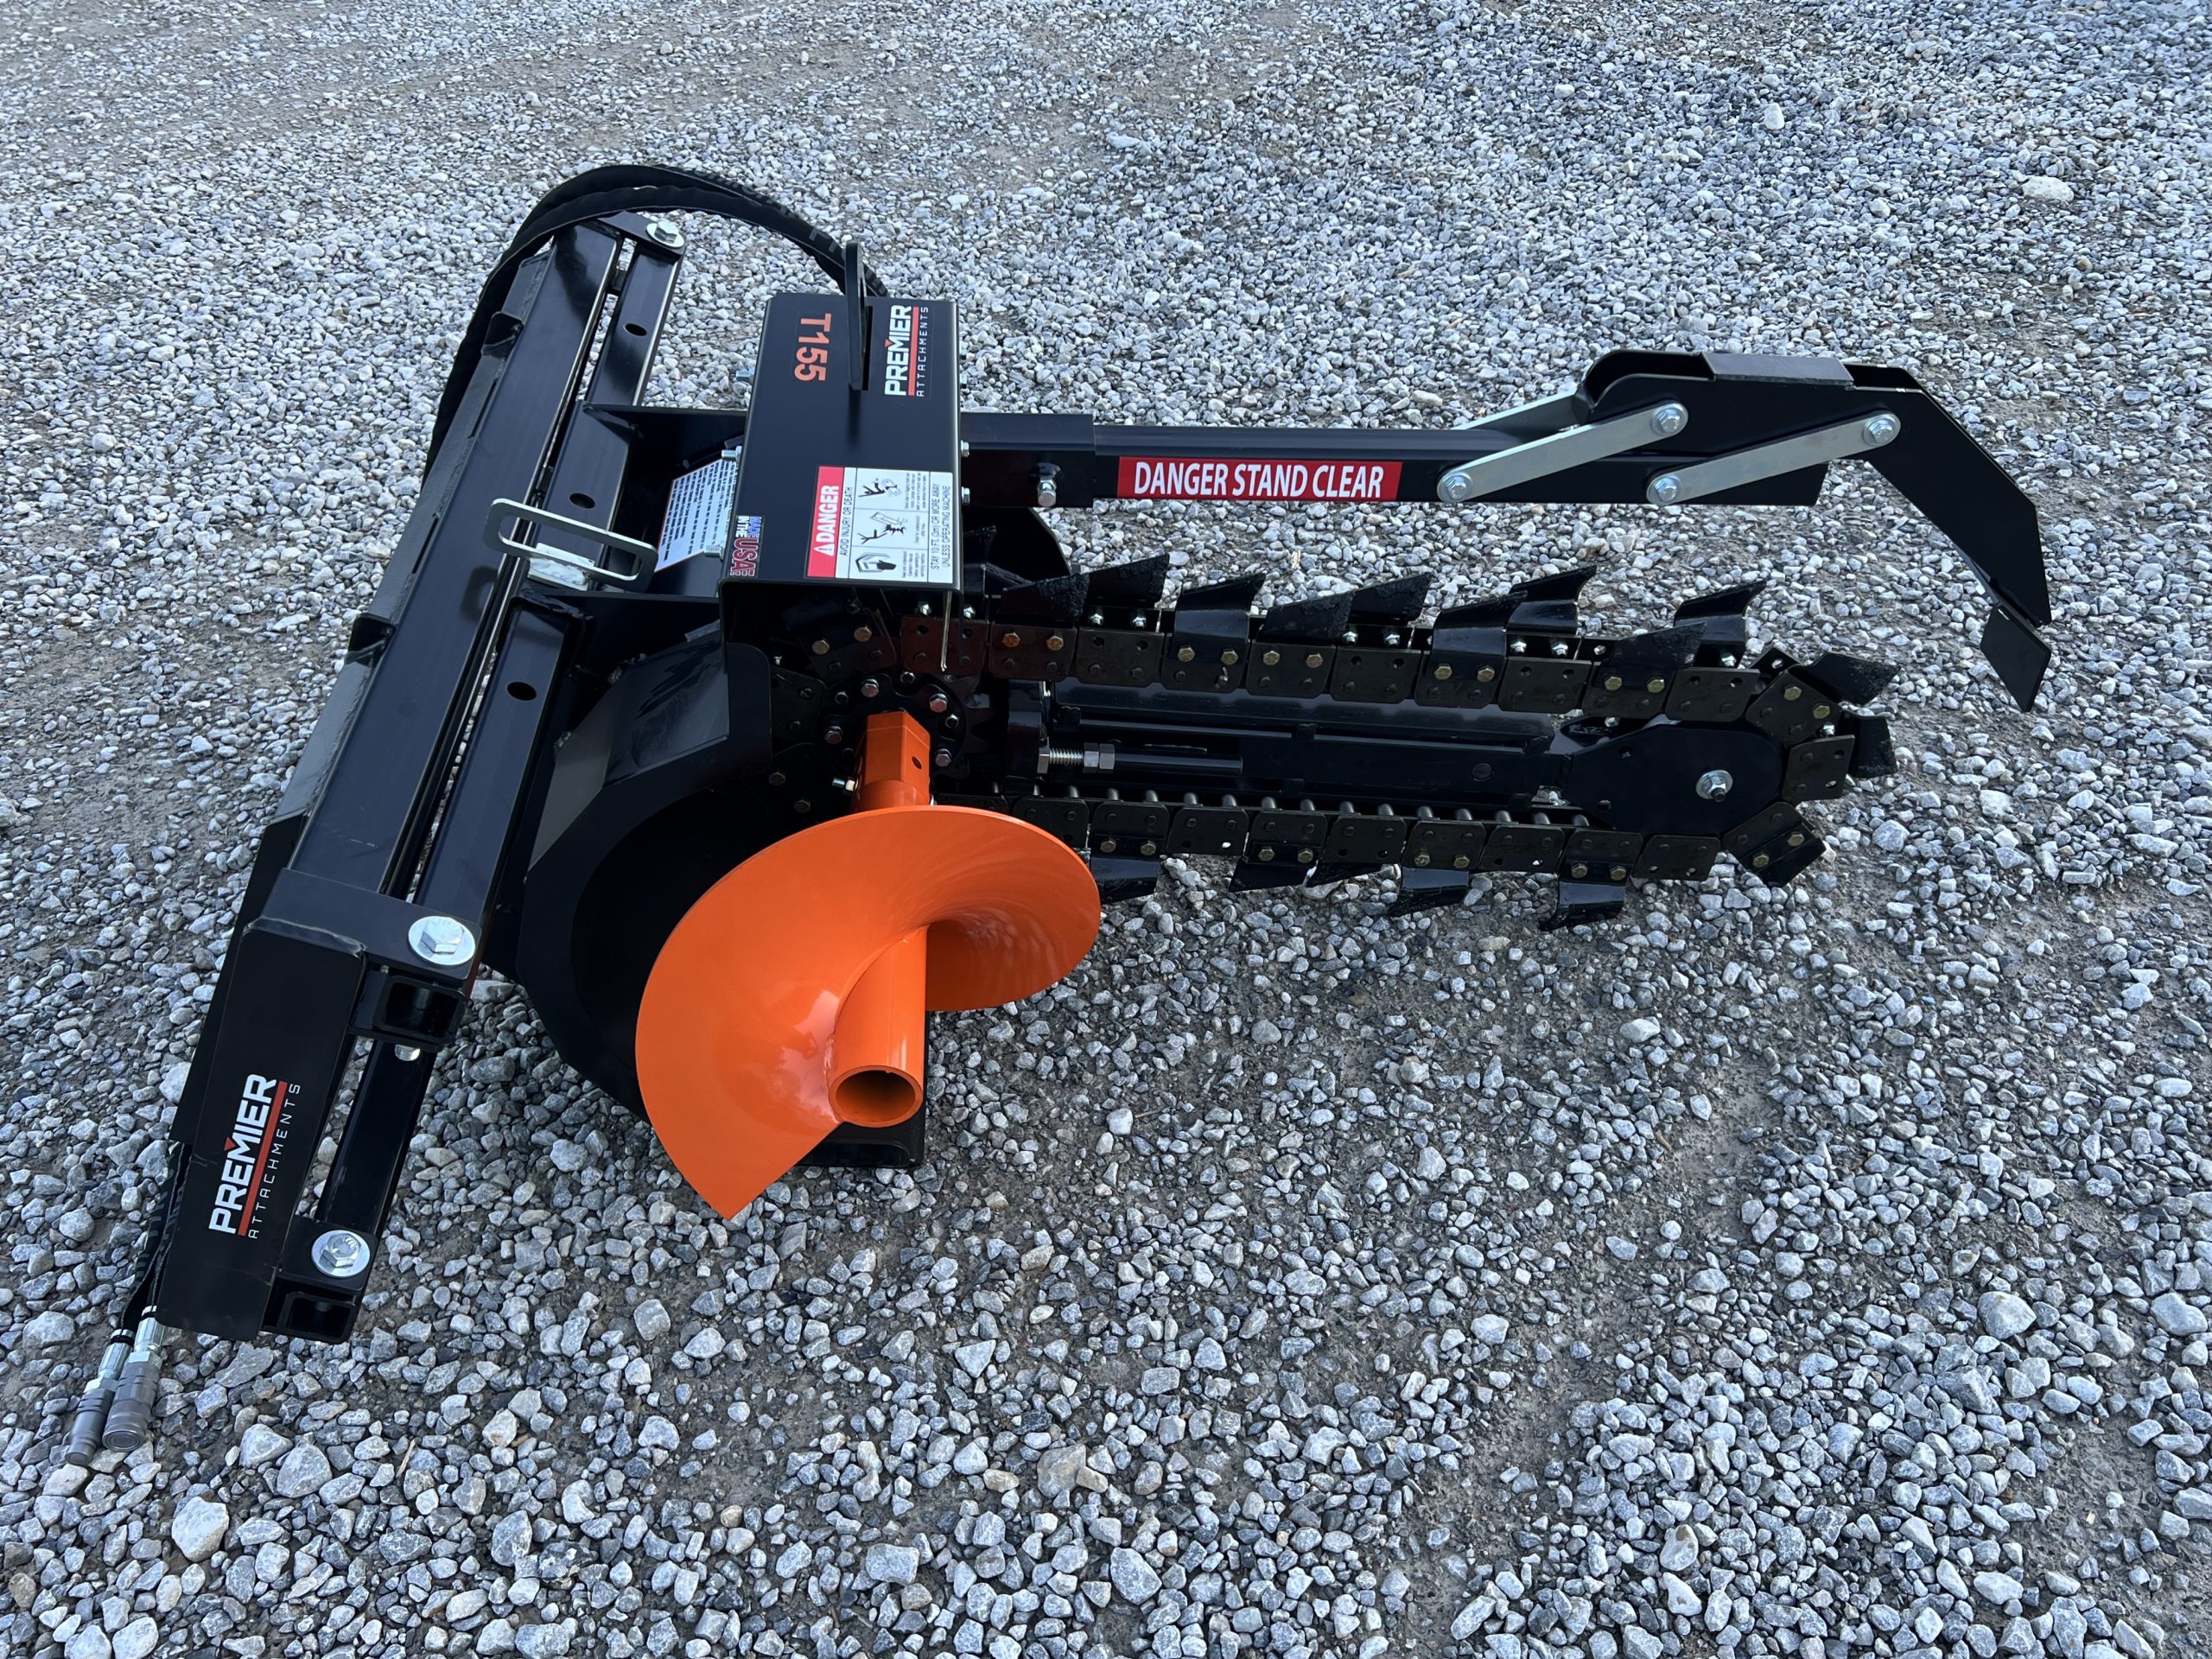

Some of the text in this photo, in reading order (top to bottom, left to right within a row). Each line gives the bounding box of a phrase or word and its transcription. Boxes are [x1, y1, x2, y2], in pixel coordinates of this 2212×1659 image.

[794, 313, 832, 381] T155
[885, 304, 912, 396] PREMIER
[916, 306, 929, 397] ATTACHMENTS
[932, 484, 941, 498] AWAY
[1134, 461, 1384, 498] DANGER STAND CLEAR
[816, 485, 840, 543] DANGER
[839, 486, 854, 556] AVOID INJURY OR DEATH
[931, 498, 941, 514] MORE
[931, 516, 940, 524] OR
[747, 516, 762, 538] MADE
[942, 511, 950, 543] OPERATING
[730, 537, 759, 572] USA
[931, 556, 940, 569] STAY
[942, 544, 950, 568] UNLESS
[208, 1074, 276, 1234] PREMIER
[248, 1083, 301, 1239] ATTACHMENTS
